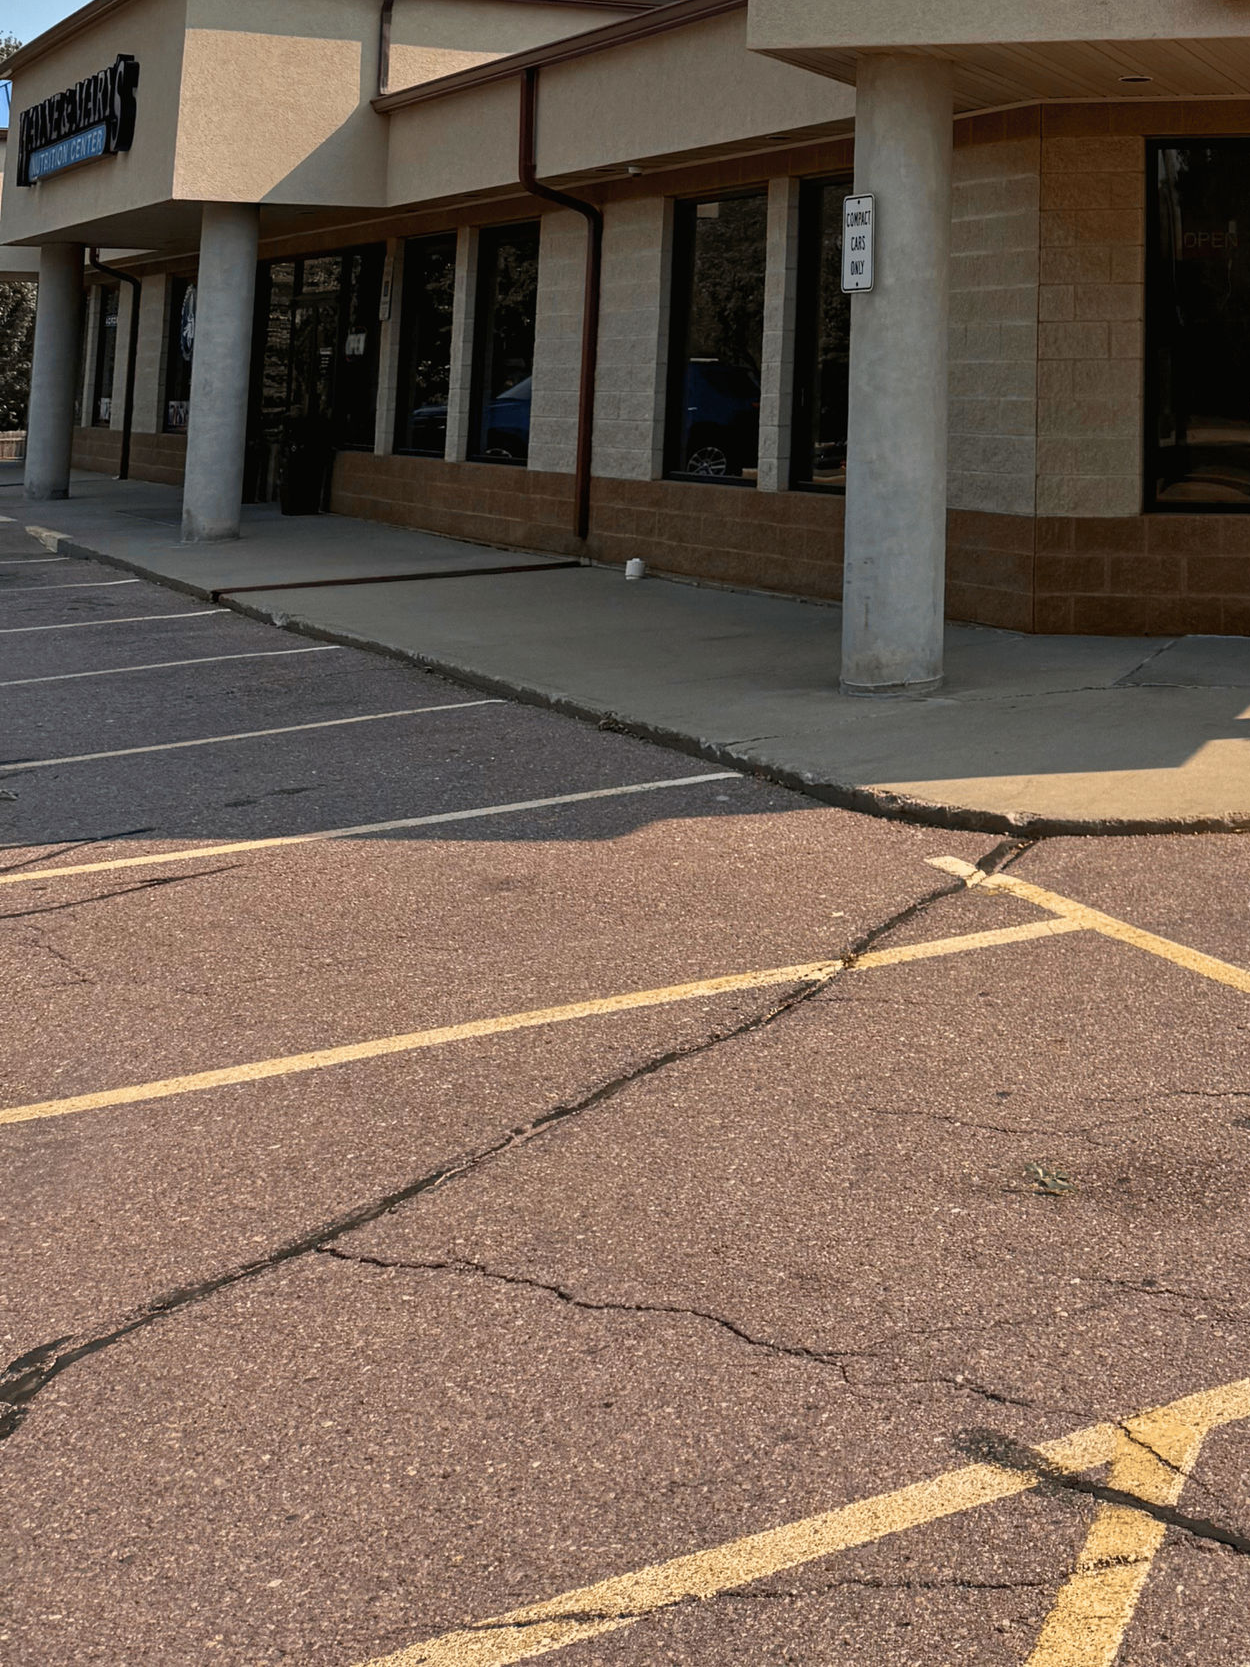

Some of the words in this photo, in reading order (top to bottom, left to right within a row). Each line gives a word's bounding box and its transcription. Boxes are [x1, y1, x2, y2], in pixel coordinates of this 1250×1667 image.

[60, 87, 74, 136] &
[30, 143, 68, 177] NUTRITION
[70, 129, 104, 161] CENTER
[846, 210, 871, 228] COMPACT
[850, 235, 866, 252] CARS
[1183, 231, 1238, 249] OPEN
[850, 260, 865, 276] ONLY
